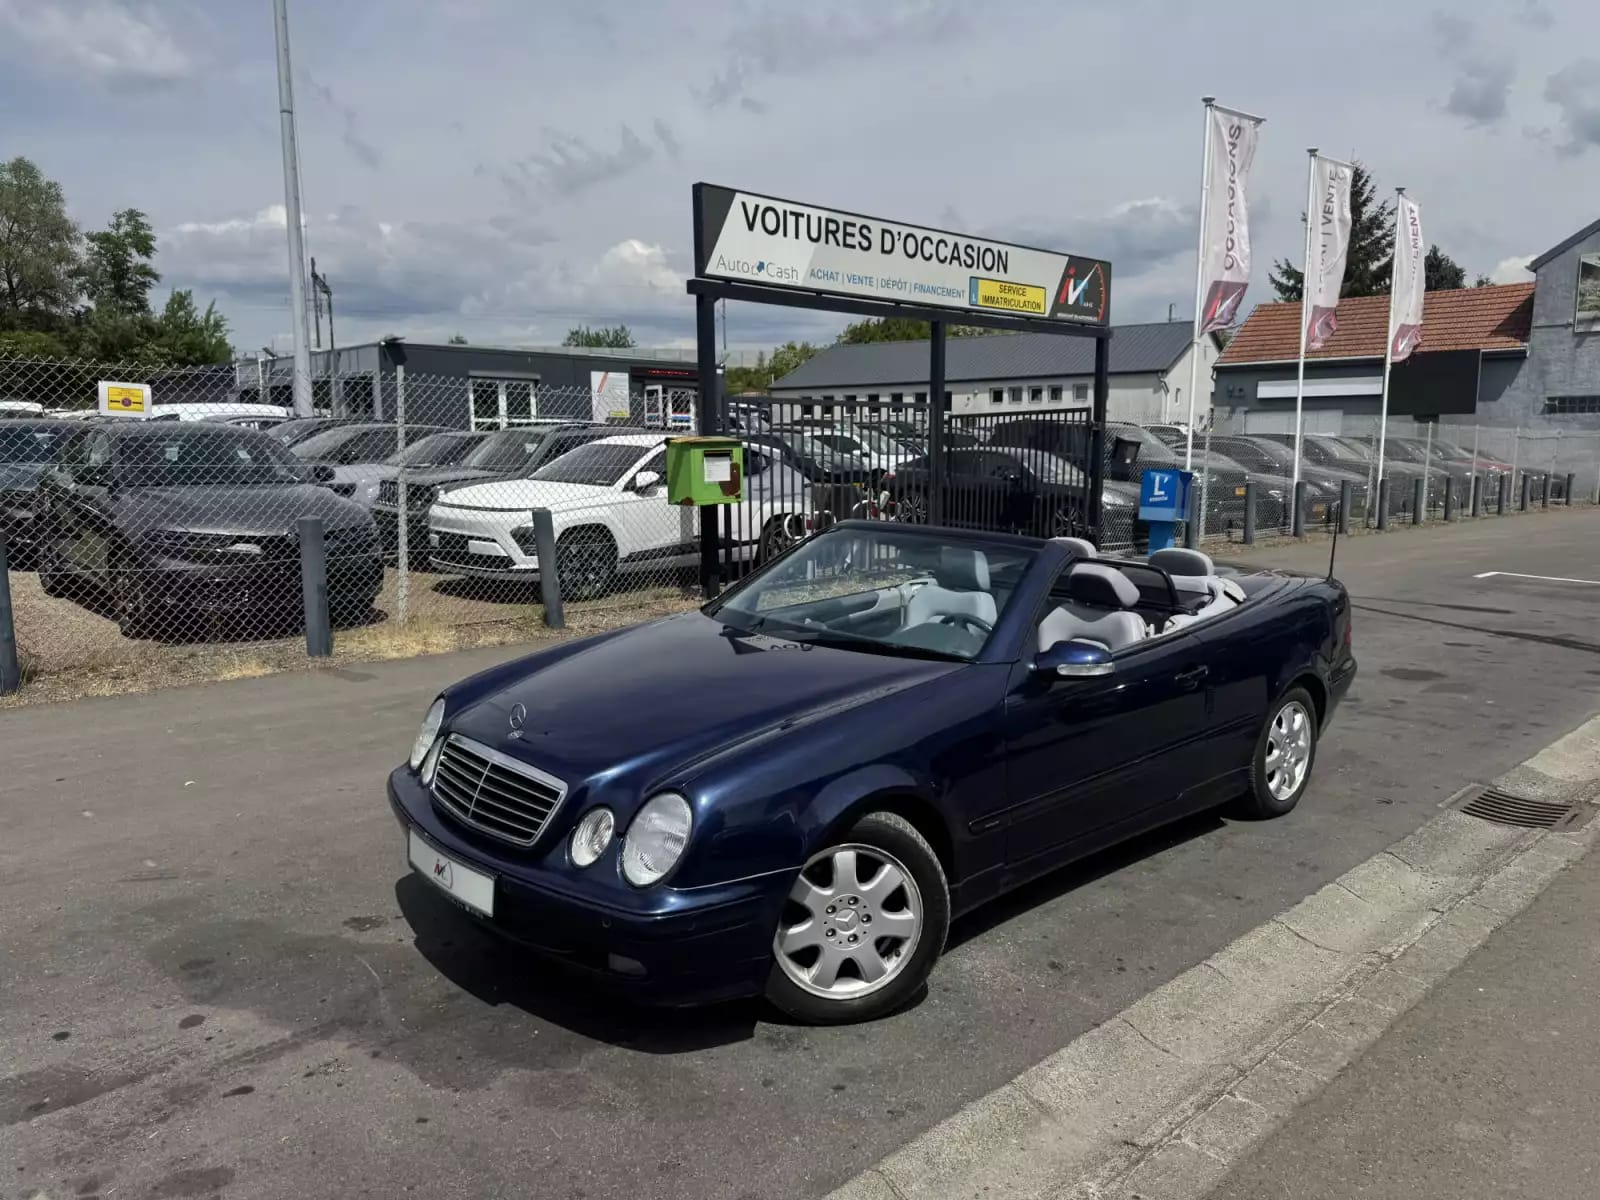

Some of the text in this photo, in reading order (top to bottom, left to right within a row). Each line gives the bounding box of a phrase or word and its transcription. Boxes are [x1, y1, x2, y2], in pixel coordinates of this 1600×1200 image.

[741, 201, 1009, 274] VOITURES D'OCCASION
[716, 254, 799, 281] Auto Cash
[809, 268, 965, 299] ACHAT VENTE DÉPÔT FINANCEMENT
[999, 284, 1027, 296] SERVICE
[982, 295, 1042, 310] IMMATRICULATION
